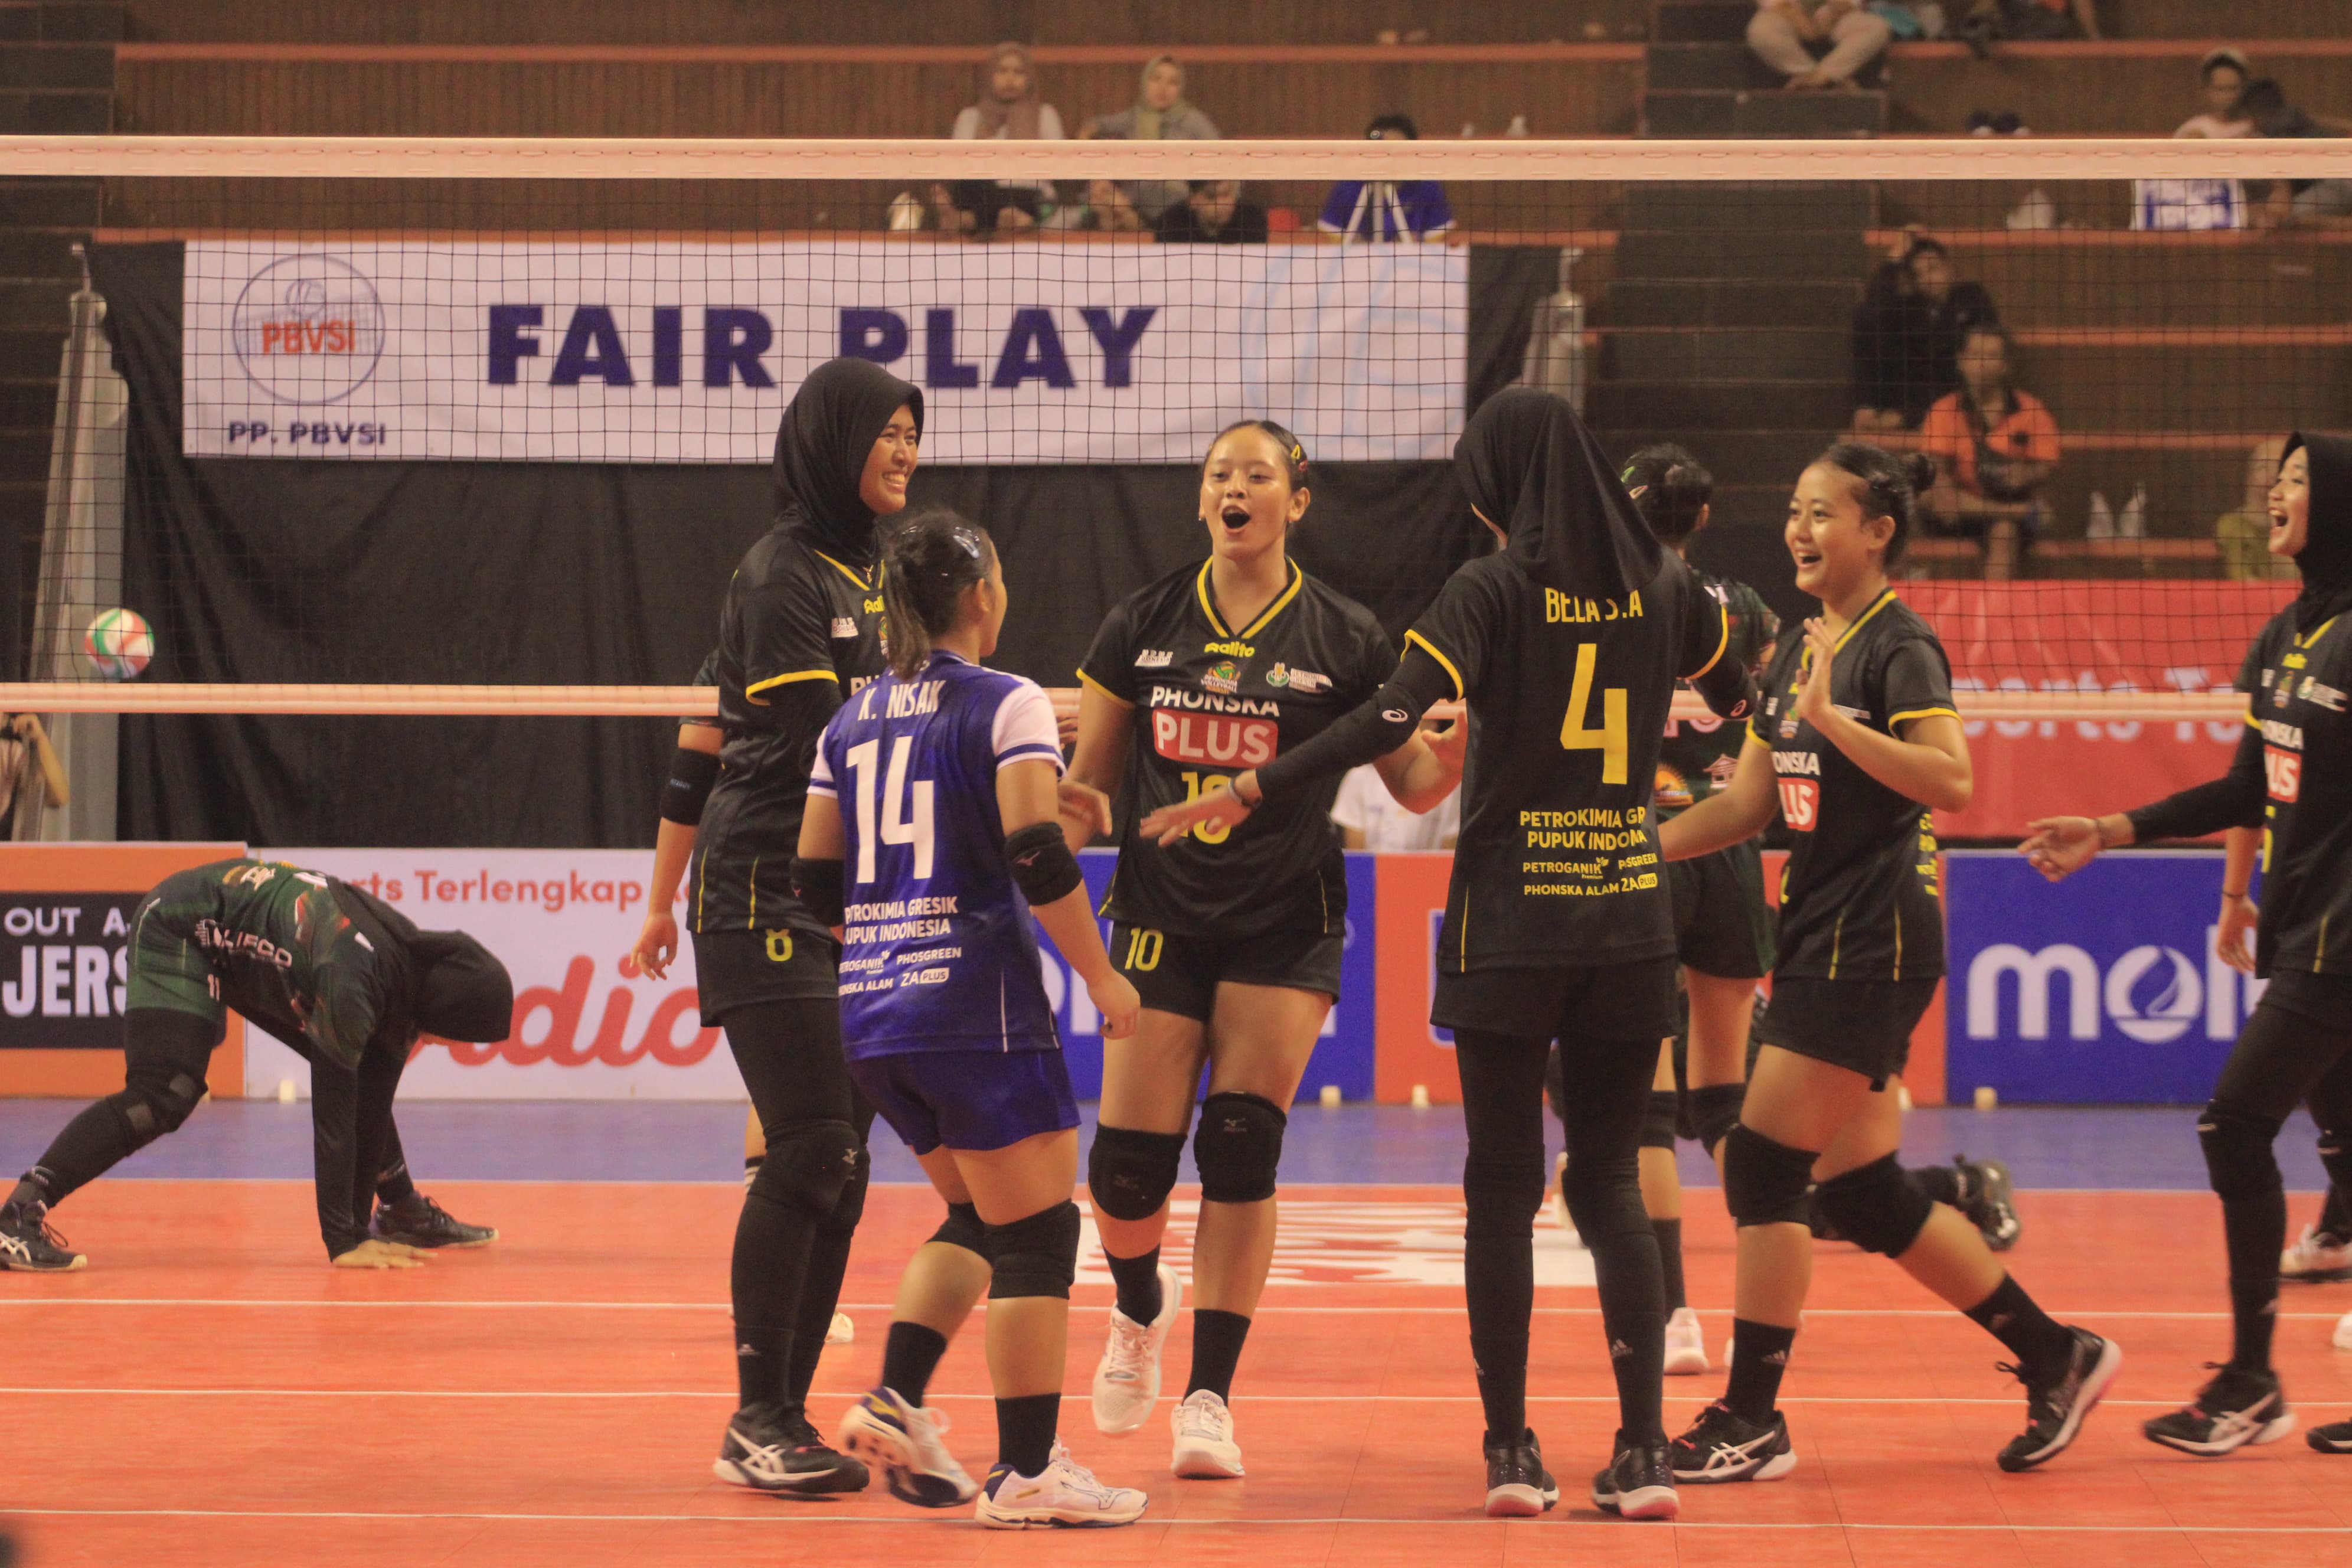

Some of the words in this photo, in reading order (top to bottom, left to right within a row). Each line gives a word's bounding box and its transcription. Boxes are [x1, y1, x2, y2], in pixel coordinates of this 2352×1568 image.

[262, 319, 355, 355] PBVSI
[488, 305, 777, 388] FAIR
[839, 306, 1158, 389] PLAY
[229, 421, 279, 443] PP.
[290, 421, 386, 445] PBVSI
[1545, 587, 1600, 623] BELA
[858, 687, 877, 721] K.
[886, 680, 947, 718] NISAK
[1560, 643, 1628, 785] 4
[1156, 711, 1270, 763] PLUS
[846, 736, 935, 883] 14
[1520, 808, 1623, 828] PETROKIMIA
[1527, 831, 1586, 849] PUPUK
[1523, 861, 1602, 874] PETROGANIK
[415, 870, 642, 913] Terlengkap
[1524, 885, 1583, 896] PHONSKA
[1586, 883, 1619, 896] ALAM
[1639, 877, 1657, 886] PLUS
[907, 896, 958, 916] GRESIK
[4, 907, 81, 937] OUT
[102, 907, 131, 937] A
[845, 925, 878, 945] UPUK
[878, 918, 951, 942] INDONESIA
[897, 947, 962, 965] PHOSGREEN
[1125, 927, 1163, 971] 10
[865, 978, 894, 992] ALAM
[900, 971, 919, 987] ZA
[923, 972, 946, 981] PLUS
